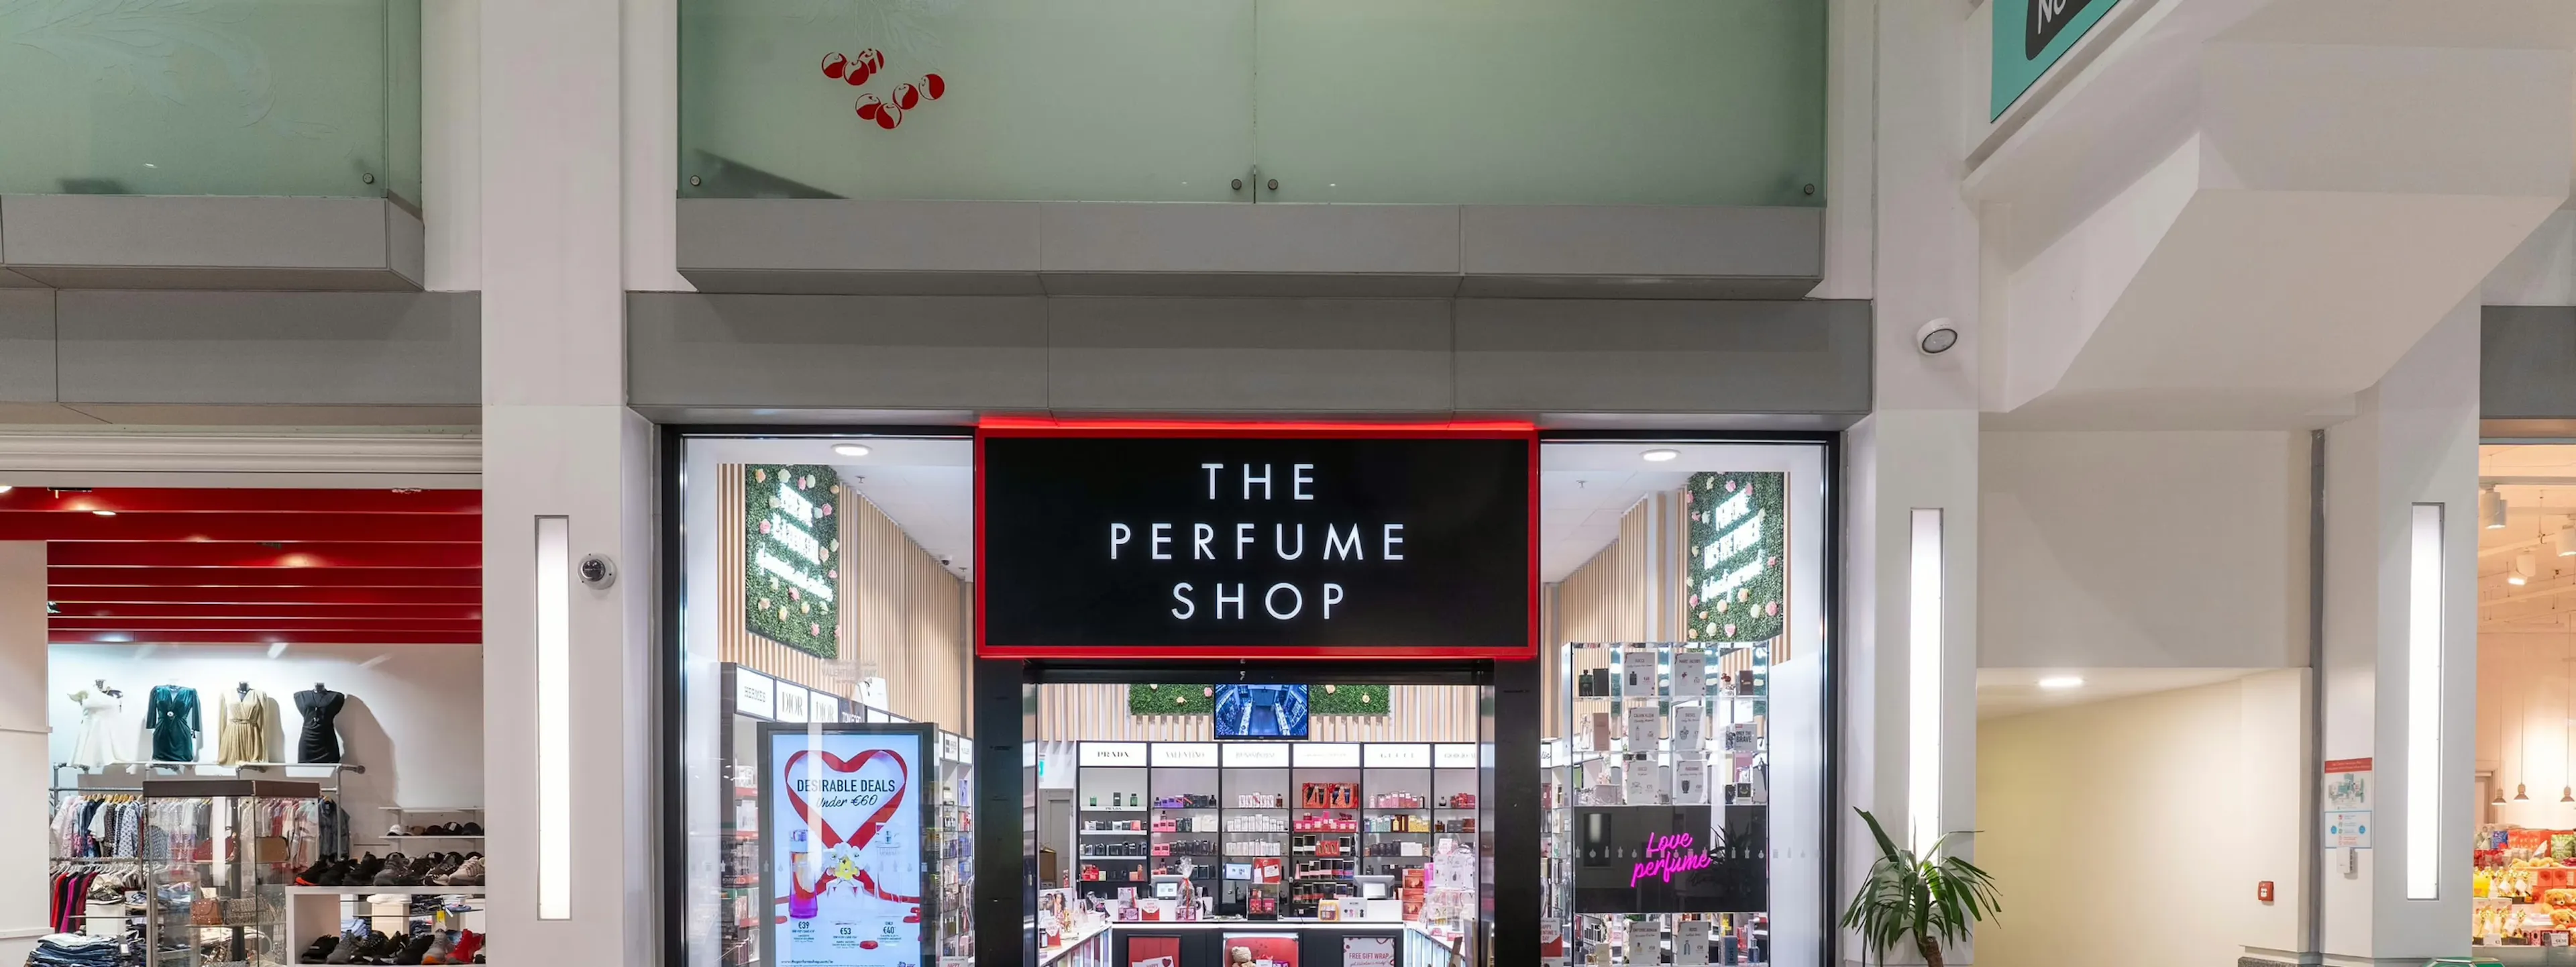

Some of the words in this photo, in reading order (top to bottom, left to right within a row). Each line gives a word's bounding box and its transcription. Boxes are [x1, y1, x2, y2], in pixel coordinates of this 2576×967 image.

[1201, 463, 1314, 501] THE
[1110, 523, 1404, 561] PERFUME
[1171, 582, 1344, 621] SHOP
[782, 691, 803, 717] DIOR
[816, 701, 834, 723] DIOR
[797, 779, 857, 792] DESIRABLE
[861, 779, 895, 792] DEALS
[816, 795, 848, 807] Under
[850, 794, 878, 807] €60
[1647, 831, 1693, 852] Love
[1630, 850, 1712, 888] perfume
[798, 921, 810, 929] €39
[840, 927, 852, 935] €53
